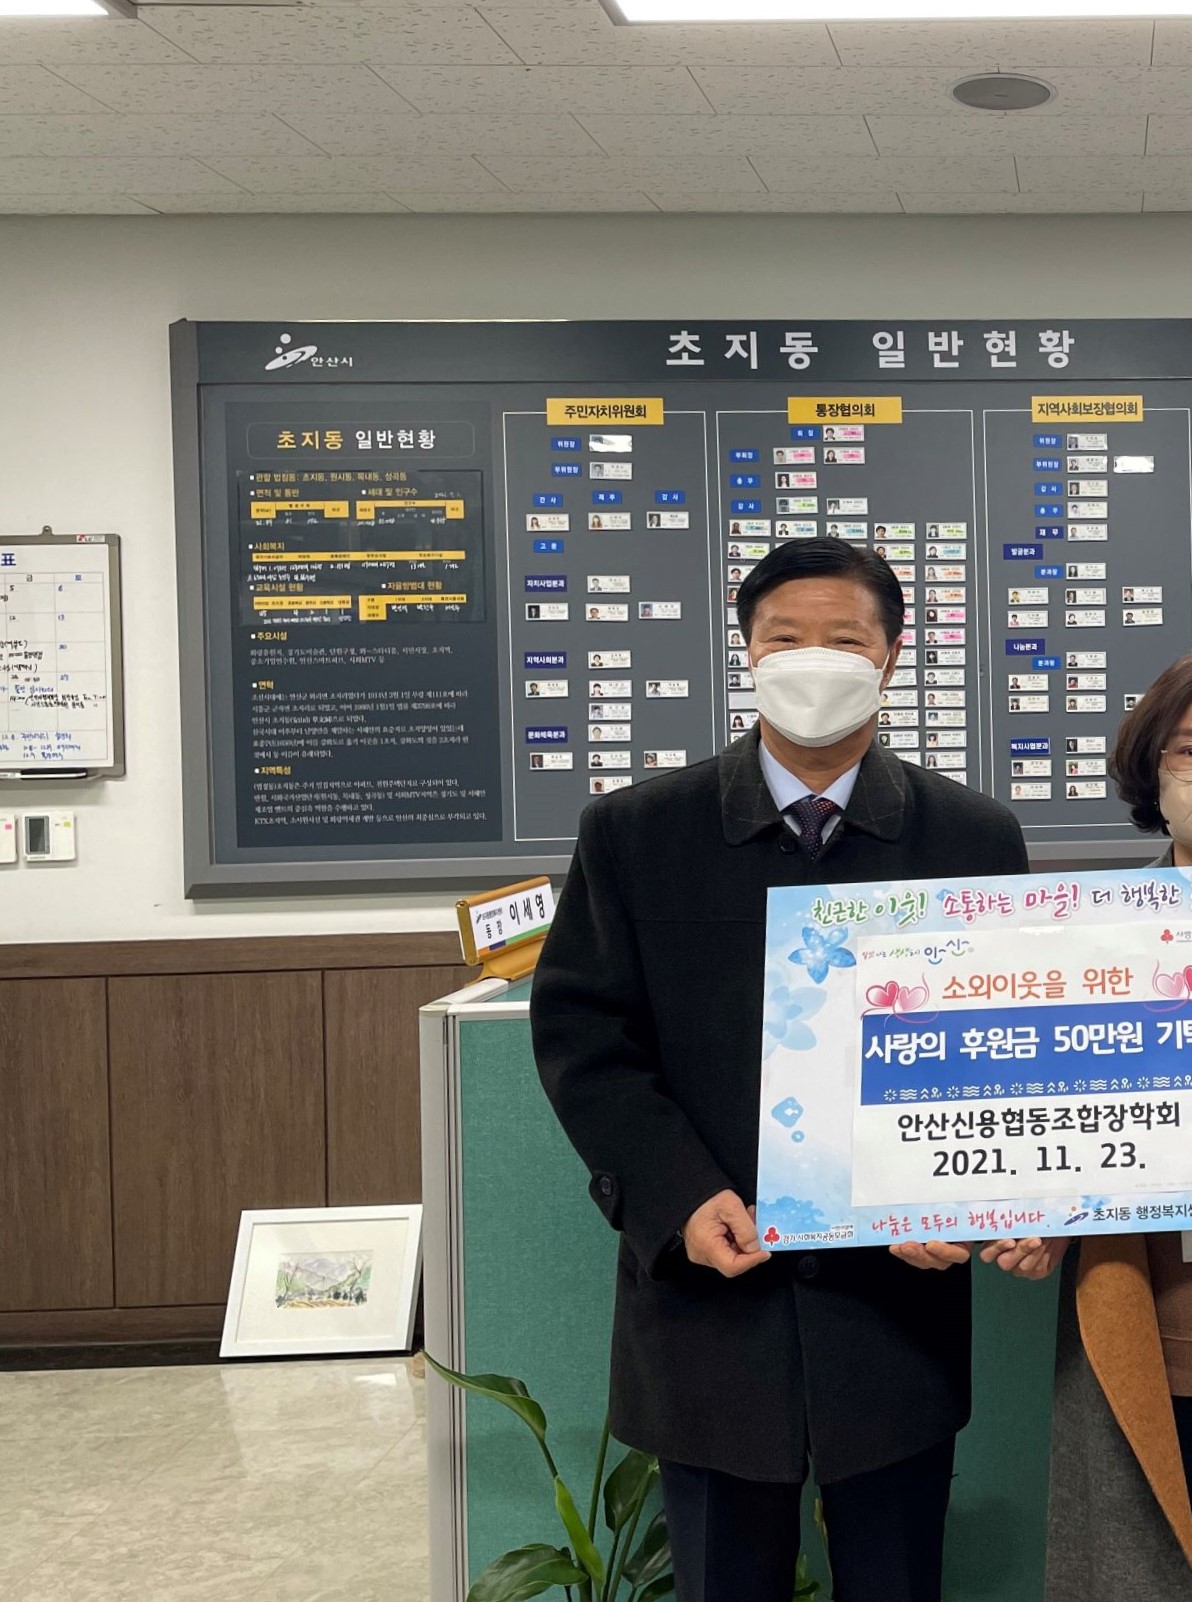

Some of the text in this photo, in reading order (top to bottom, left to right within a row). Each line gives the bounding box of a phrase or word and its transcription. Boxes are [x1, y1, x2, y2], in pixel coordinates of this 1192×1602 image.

[666, 330, 1075, 370] 초지동 일반현황
[309, 356, 353, 368] 안산시
[564, 405, 647, 419] 주민자치위원회
[815, 403, 876, 417] 통장협의회
[1037, 402, 1138, 416] 지역사회보장협의회
[276, 430, 436, 450] 초지동 일반현황
[557, 440, 576, 448] 위원장
[554, 466, 579, 474] 부위원장
[526, 580, 565, 588] 자치사업분과
[256, 632, 288, 641] 주요시설
[1013, 643, 1038, 651] 나눔분과
[526, 656, 565, 664] 지역사회분과
[527, 731, 566, 739] 문화체육분과
[1011, 742, 1049, 750] 복지사업분과
[260, 767, 292, 775] 지역특성
[813, 898, 868, 925] 친근한
[874, 891, 926, 926] 이웃!
[943, 890, 1014, 922] 소통하는
[1024, 883, 1080, 918] 마을!
[1091, 888, 1111, 904] 더
[1120, 882, 1180, 911] 행복한
[924, 938, 970, 965] 안산
[942, 966, 1134, 1001] 소외이웃을 위한
[864, 1030, 946, 1066] 사랑의
[960, 1025, 1040, 1061] 후원금
[1053, 1020, 1144, 1054] 50만원
[898, 1101, 1180, 1142] 안산신용협동조합장학회
[932, 1142, 1146, 1177] 2021. 11. 23.
[1092, 1206, 1132, 1222] 초지동
[871, 1209, 1051, 1237] 나눔은 모두의 행복입니다.
